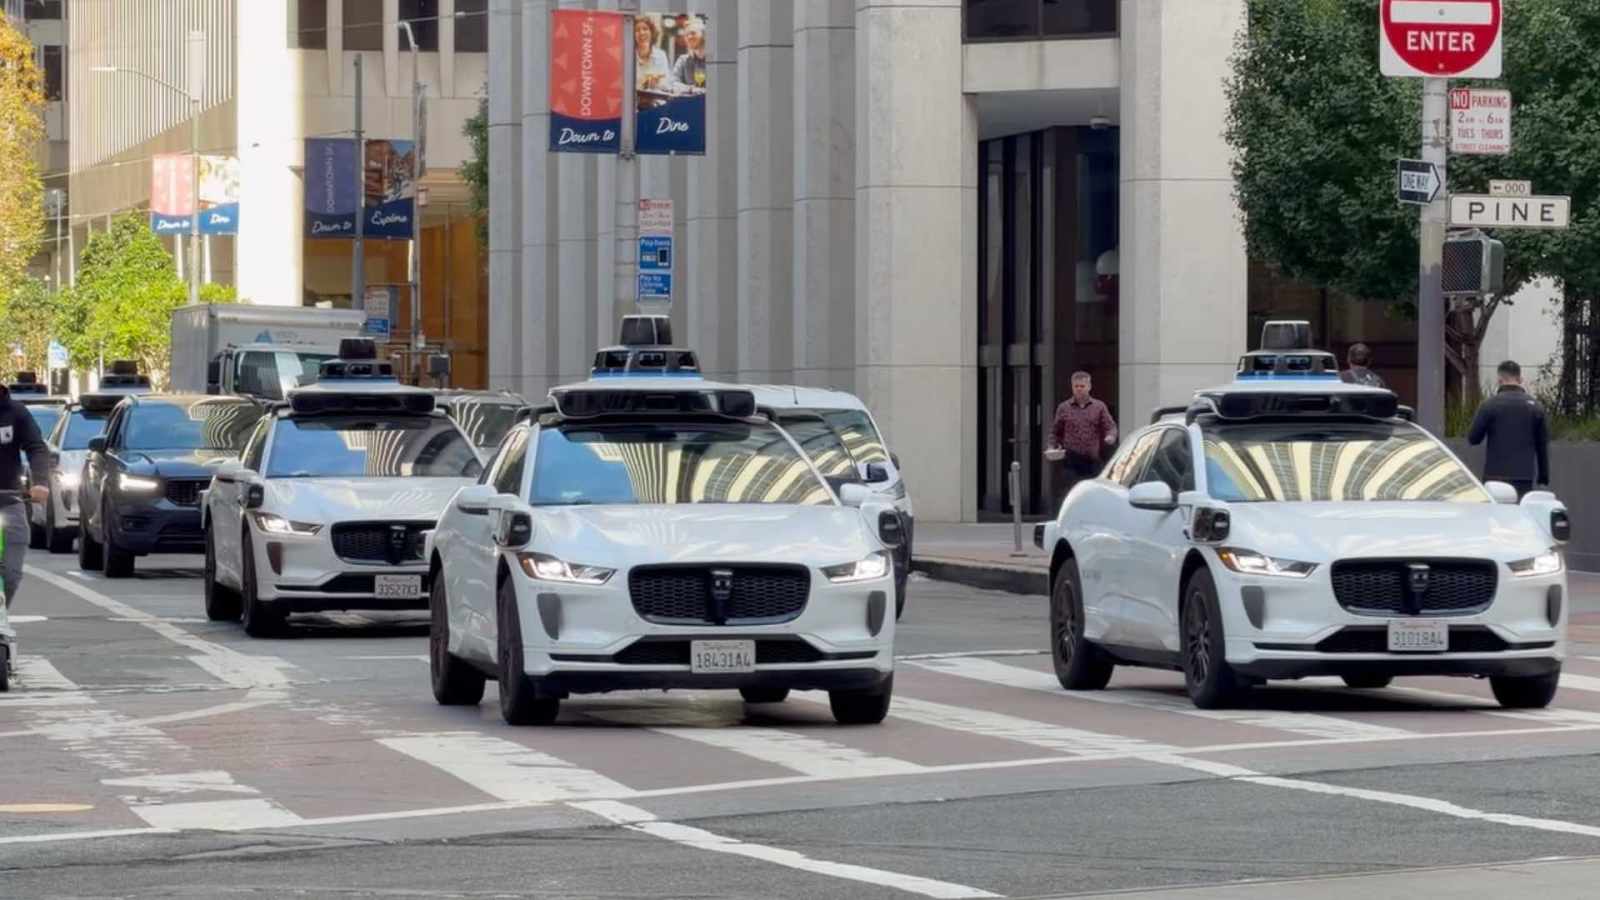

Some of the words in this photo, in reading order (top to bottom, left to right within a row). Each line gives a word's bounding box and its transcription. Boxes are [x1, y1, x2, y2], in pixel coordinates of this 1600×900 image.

[1407, 30, 1475, 52] ENTER
[580, 38, 593, 116] DOWNTOWN
[1451, 90, 1469, 109] NO
[1472, 95, 1509, 109] PARKING
[656, 117, 689, 134] Dine
[558, 127, 600, 144] Down
[602, 129, 615, 141] to
[1403, 174, 1416, 189] ONE
[1416, 175, 1431, 190] WAY
[1504, 183, 1526, 193] 000
[1468, 202, 1555, 222] PINE
[312, 220, 341, 234] Down
[696, 652, 751, 669] 18431A4
